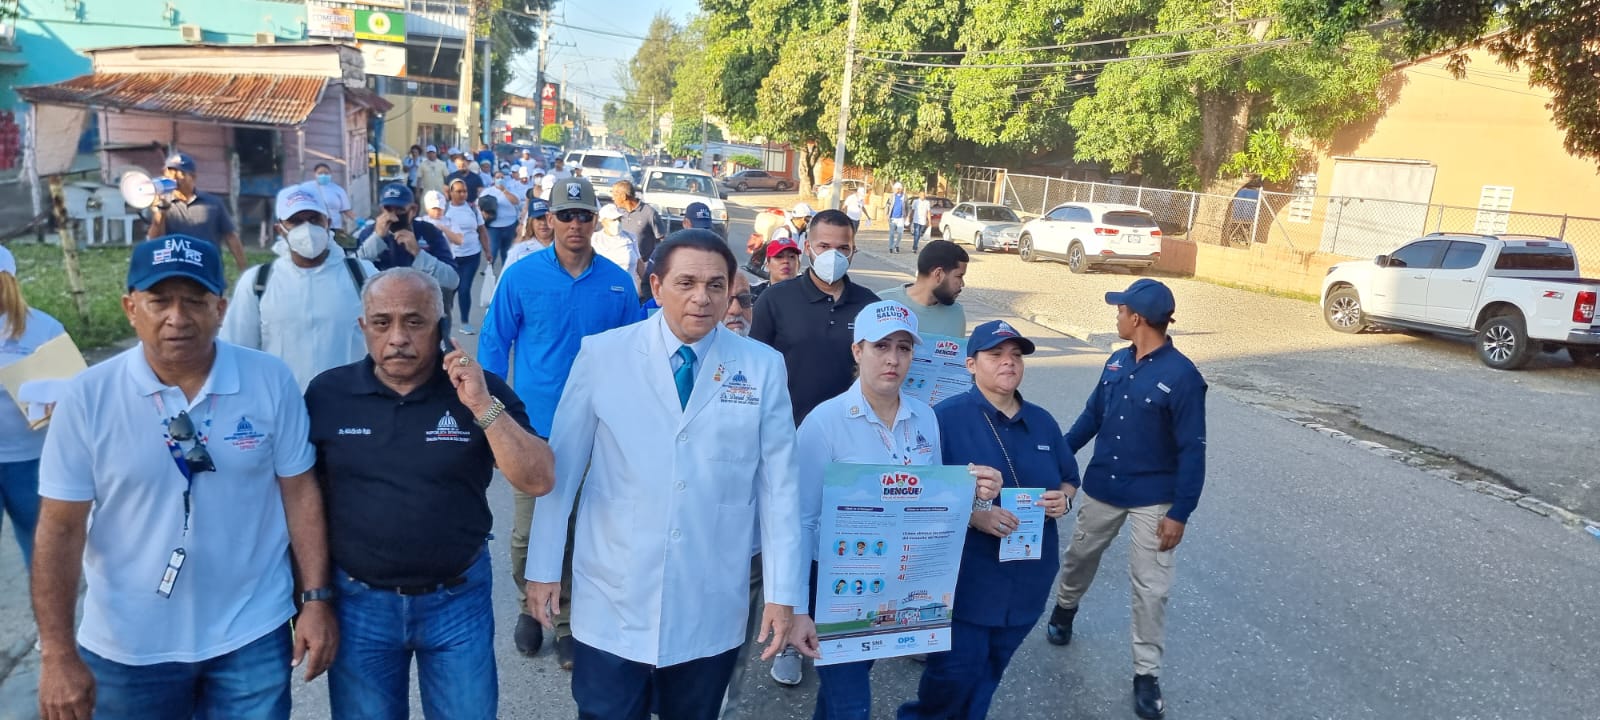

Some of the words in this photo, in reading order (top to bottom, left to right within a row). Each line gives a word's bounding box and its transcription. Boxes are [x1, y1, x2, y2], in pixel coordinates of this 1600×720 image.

[877, 311, 902, 319] SALUD
[882, 474, 918, 486] ¡ALTO
[897, 636, 916, 644] OPS
